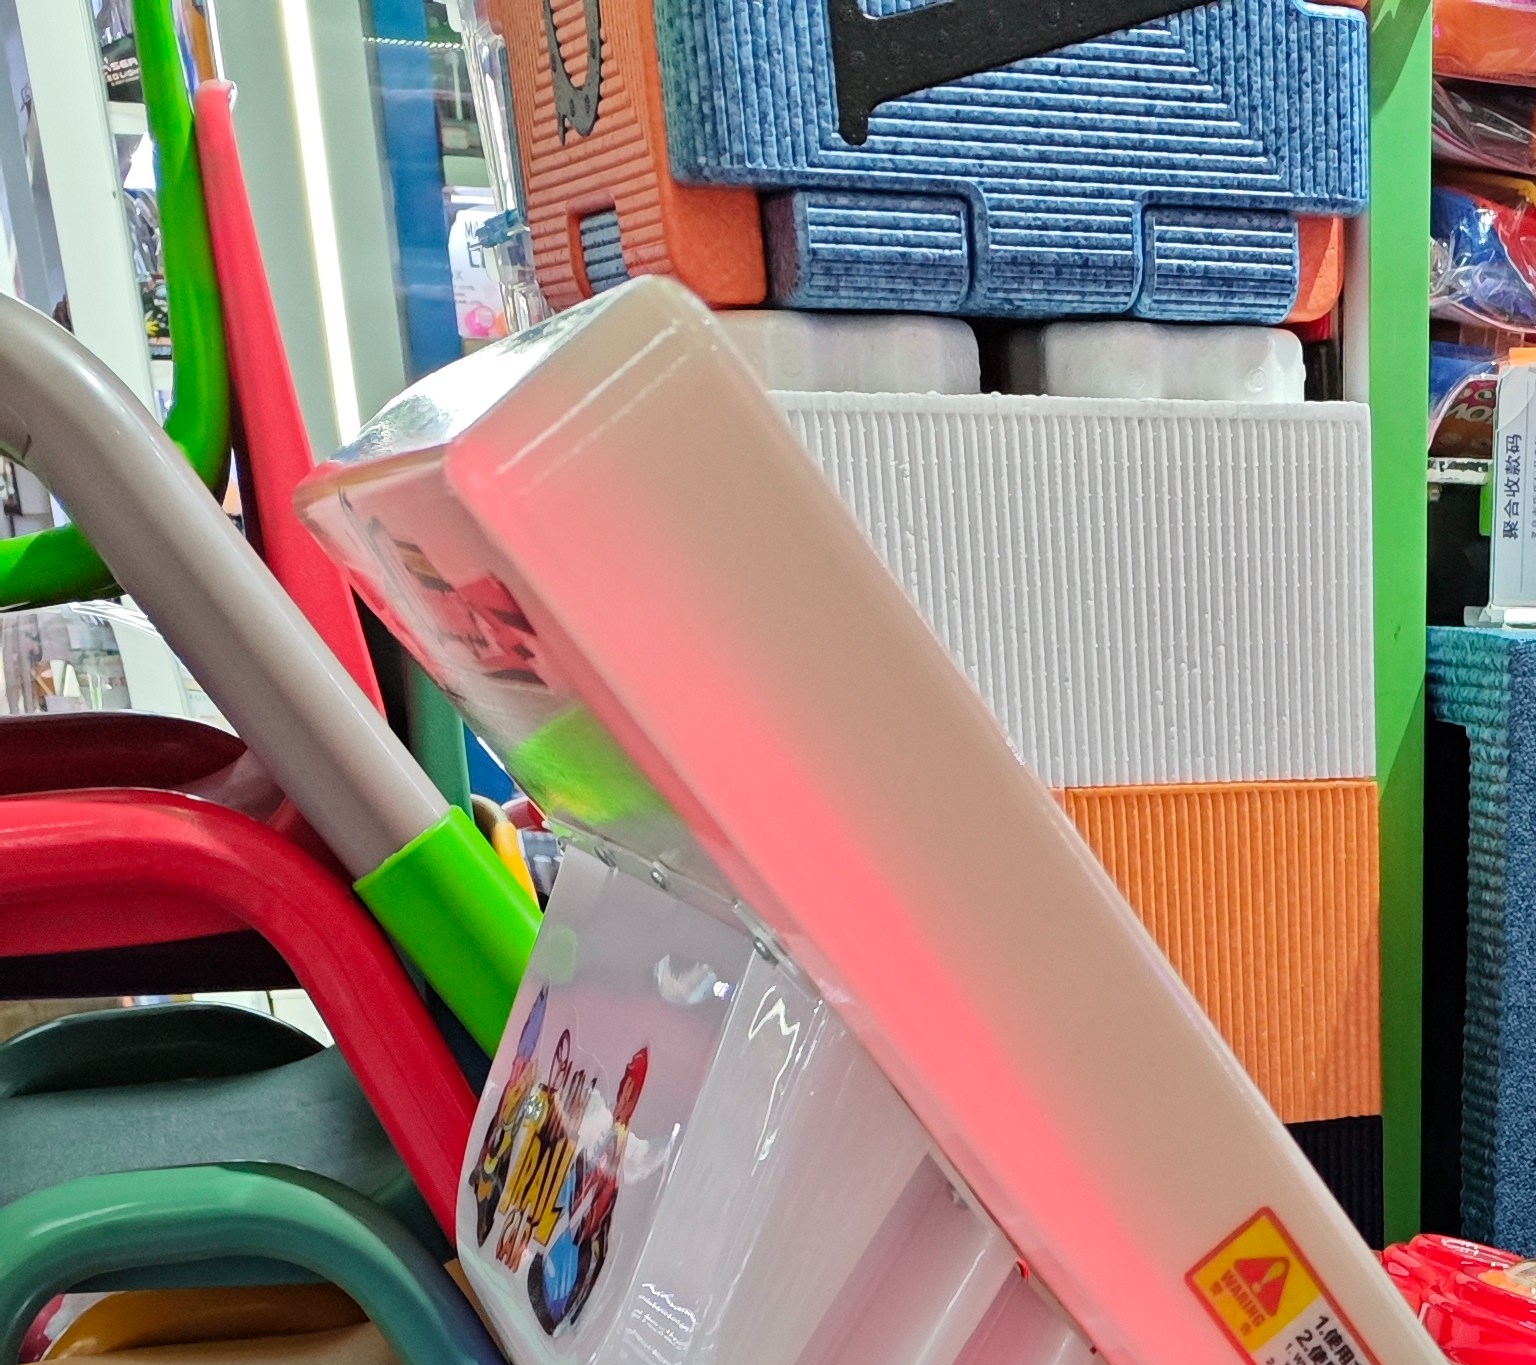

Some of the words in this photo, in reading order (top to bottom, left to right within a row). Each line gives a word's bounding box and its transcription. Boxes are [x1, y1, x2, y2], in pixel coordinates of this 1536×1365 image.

[1502, 434, 1522, 540] 聚合收款码
